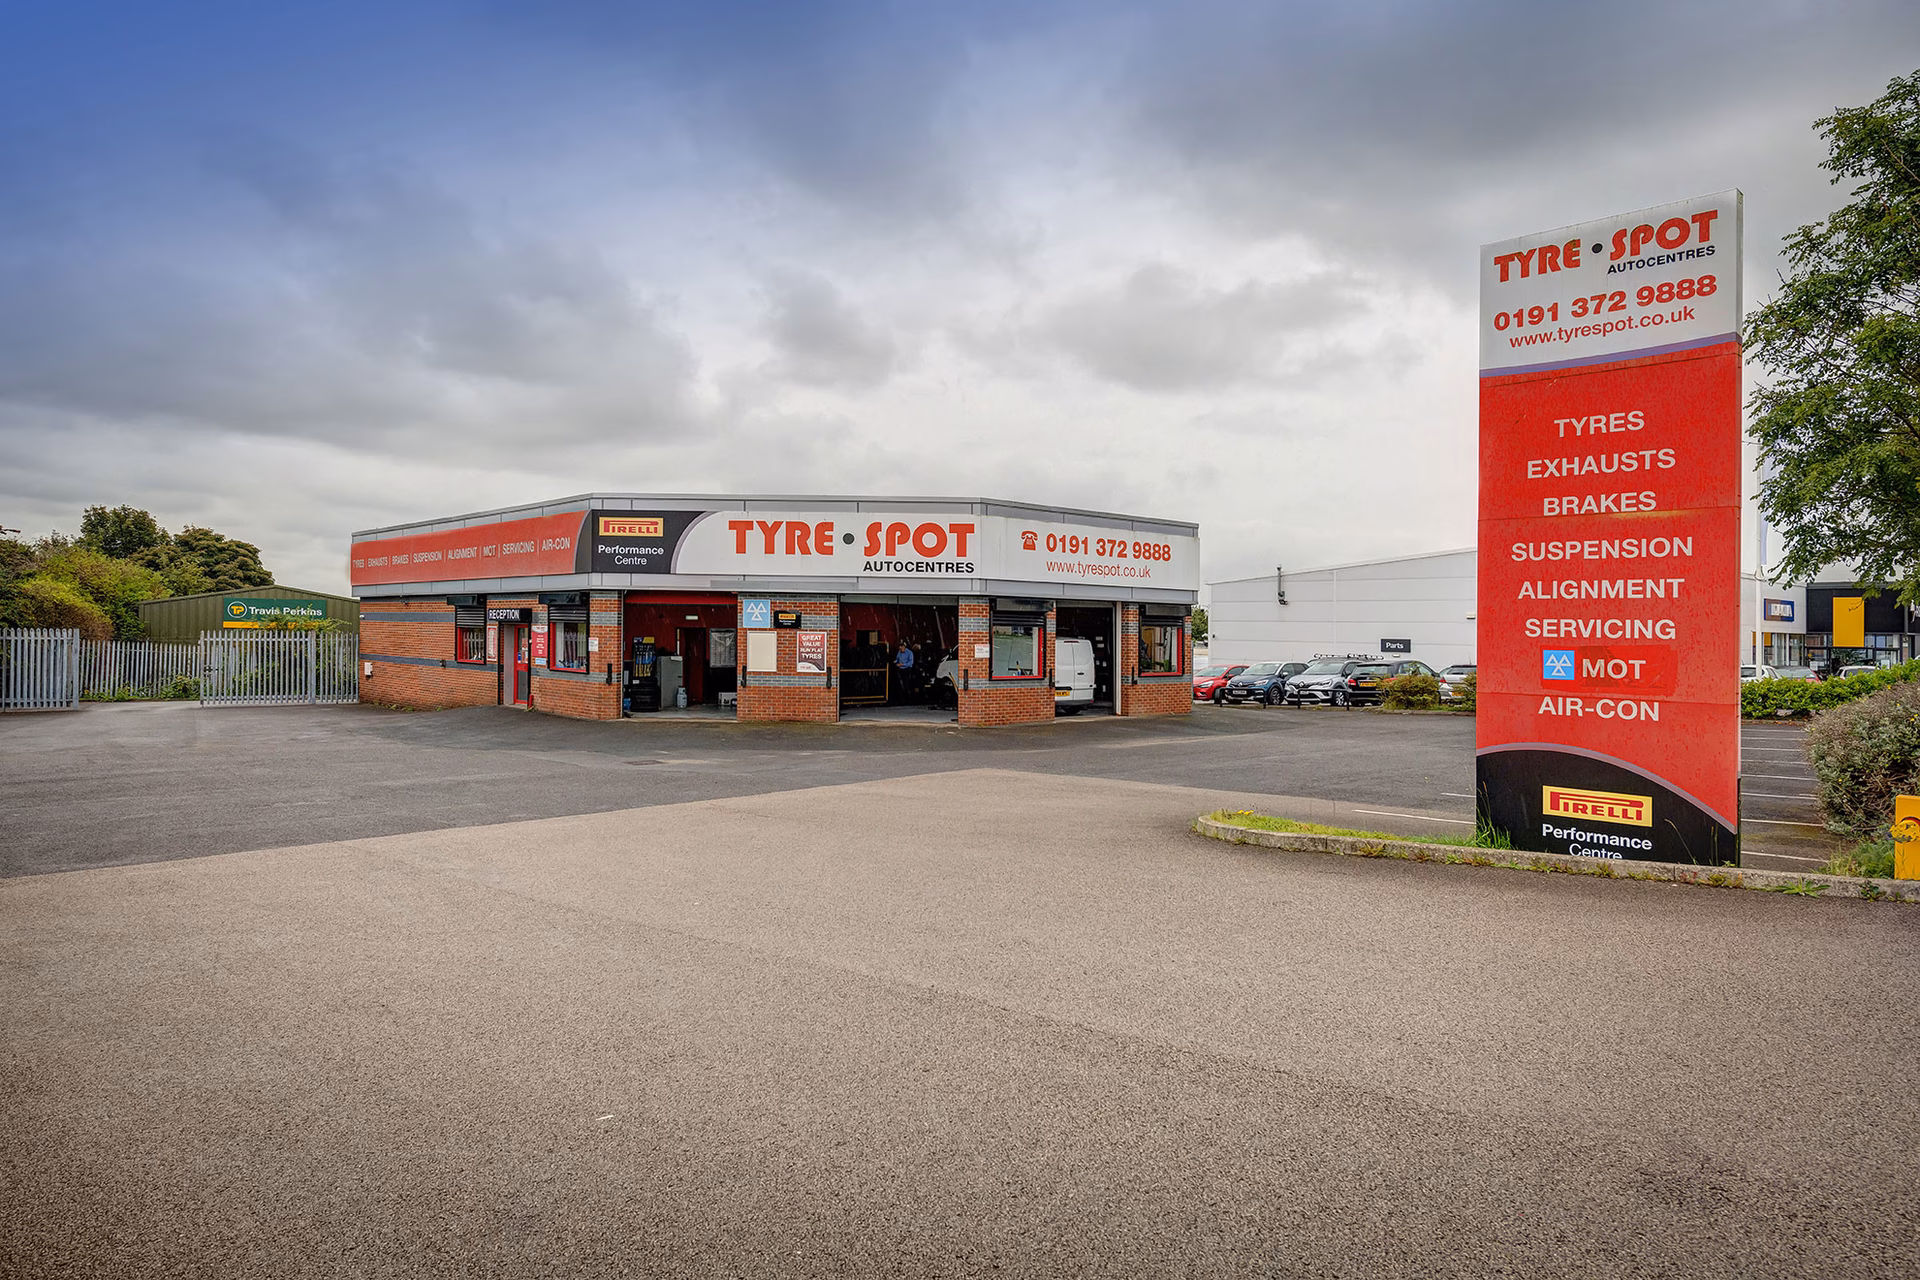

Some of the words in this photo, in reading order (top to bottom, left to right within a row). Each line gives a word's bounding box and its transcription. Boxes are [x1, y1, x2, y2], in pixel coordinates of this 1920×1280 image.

[1494, 239, 1581, 282] TYRE
[1610, 209, 1718, 260] SPOT
[1607, 245, 1715, 274] AUTOCENTRES
[1494, 302, 1558, 330] 0191
[1571, 290, 1627, 318] 372
[1636, 274, 1717, 306] 9888
[1509, 305, 1695, 348] www.tyrespot.co.uk
[1554, 410, 1645, 437] TYRES
[1527, 448, 1676, 479] EXHAUSTS
[1543, 491, 1657, 516] BRAKES
[603, 520, 659, 534] PIRELLI
[728, 520, 834, 555] TYRE
[864, 521, 975, 558] SPOT
[367, 556, 388, 567] EXHAUSTS
[392, 554, 409, 565] BRAKES
[413, 551, 442, 563] SUSPENSION
[447, 546, 477, 559] ALIGNMENT
[483, 545, 496, 557] MOT
[502, 541, 534, 555] SERVICING
[541, 537, 570, 551] AIR-CON
[598, 544, 664, 555] Performance
[614, 555, 648, 565] Centre
[1046, 533, 1089, 555] 0191
[1096, 538, 1128, 559] 372
[1132, 541, 1172, 562] 9888
[1511, 537, 1693, 562] SUSPENSION
[863, 561, 975, 574] AUTOCENTRES
[1046, 560, 1151, 578] www.tyrespot.co.uk
[1518, 578, 1685, 599] ALIGNMENT
[248, 606, 280, 615] Travis
[283, 607, 322, 616] Perkins
[488, 609, 520, 619] RECEPTION
[1524, 619, 1676, 640] SERVICING
[1385, 641, 1404, 649] Parts
[1582, 659, 1646, 680] MOT
[1538, 697, 1659, 722] AIR-CON
[1550, 791, 1644, 821] PIRELLI
[1542, 823, 1653, 850] Performance
